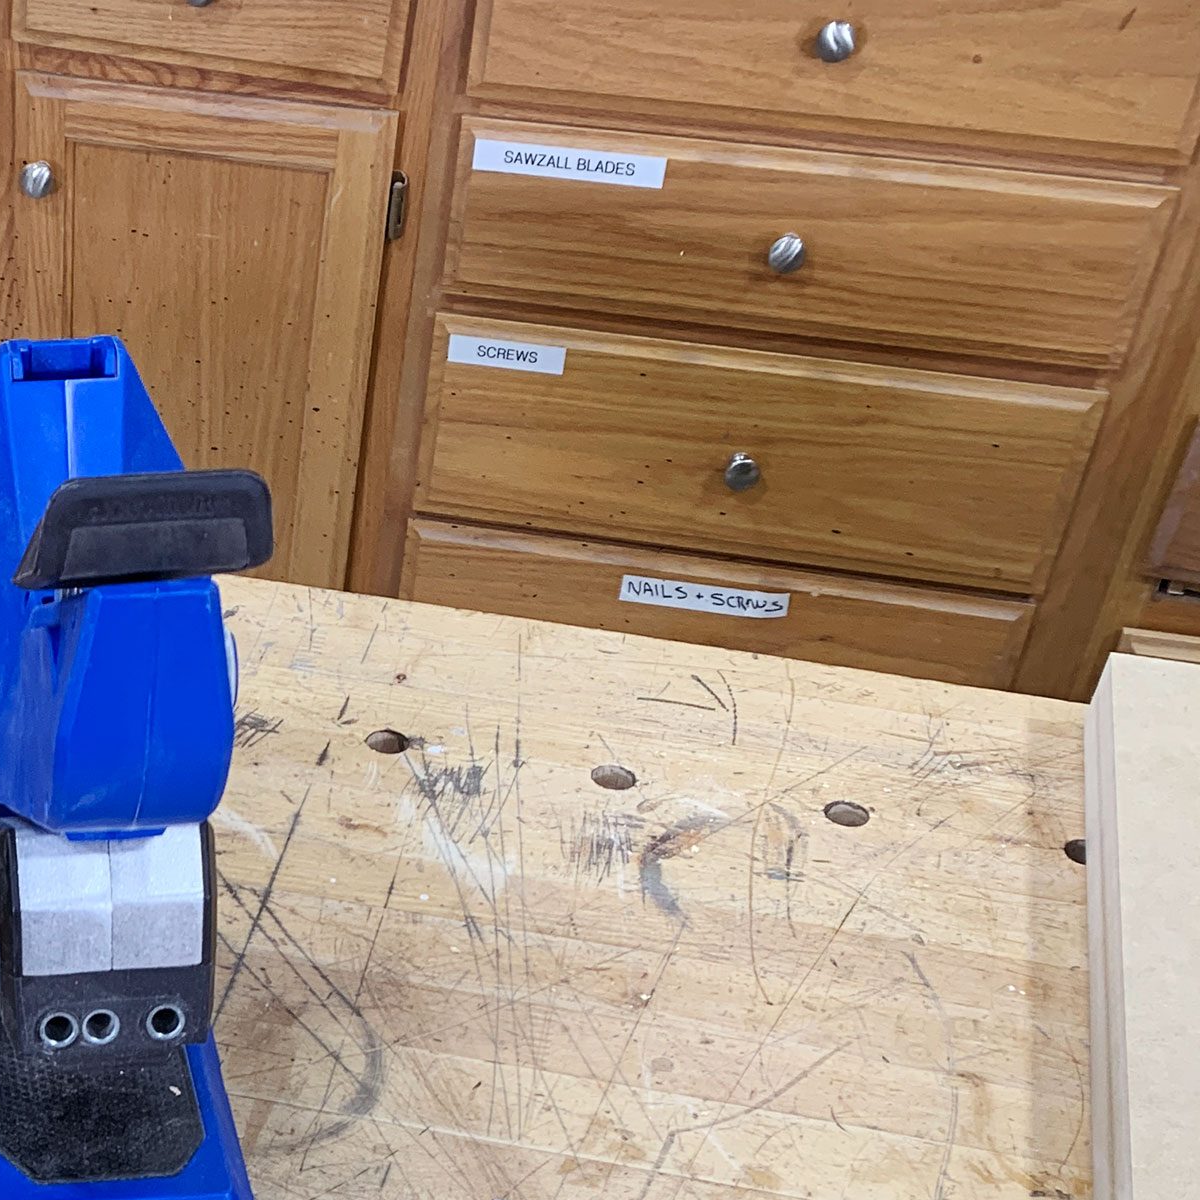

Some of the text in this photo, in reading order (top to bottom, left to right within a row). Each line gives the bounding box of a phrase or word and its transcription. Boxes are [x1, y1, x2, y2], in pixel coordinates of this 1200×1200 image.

[503, 150, 636, 177] SAWZALL BLADES
[477, 344, 538, 364] SCREWS
[627, 580, 688, 600] NAILS
